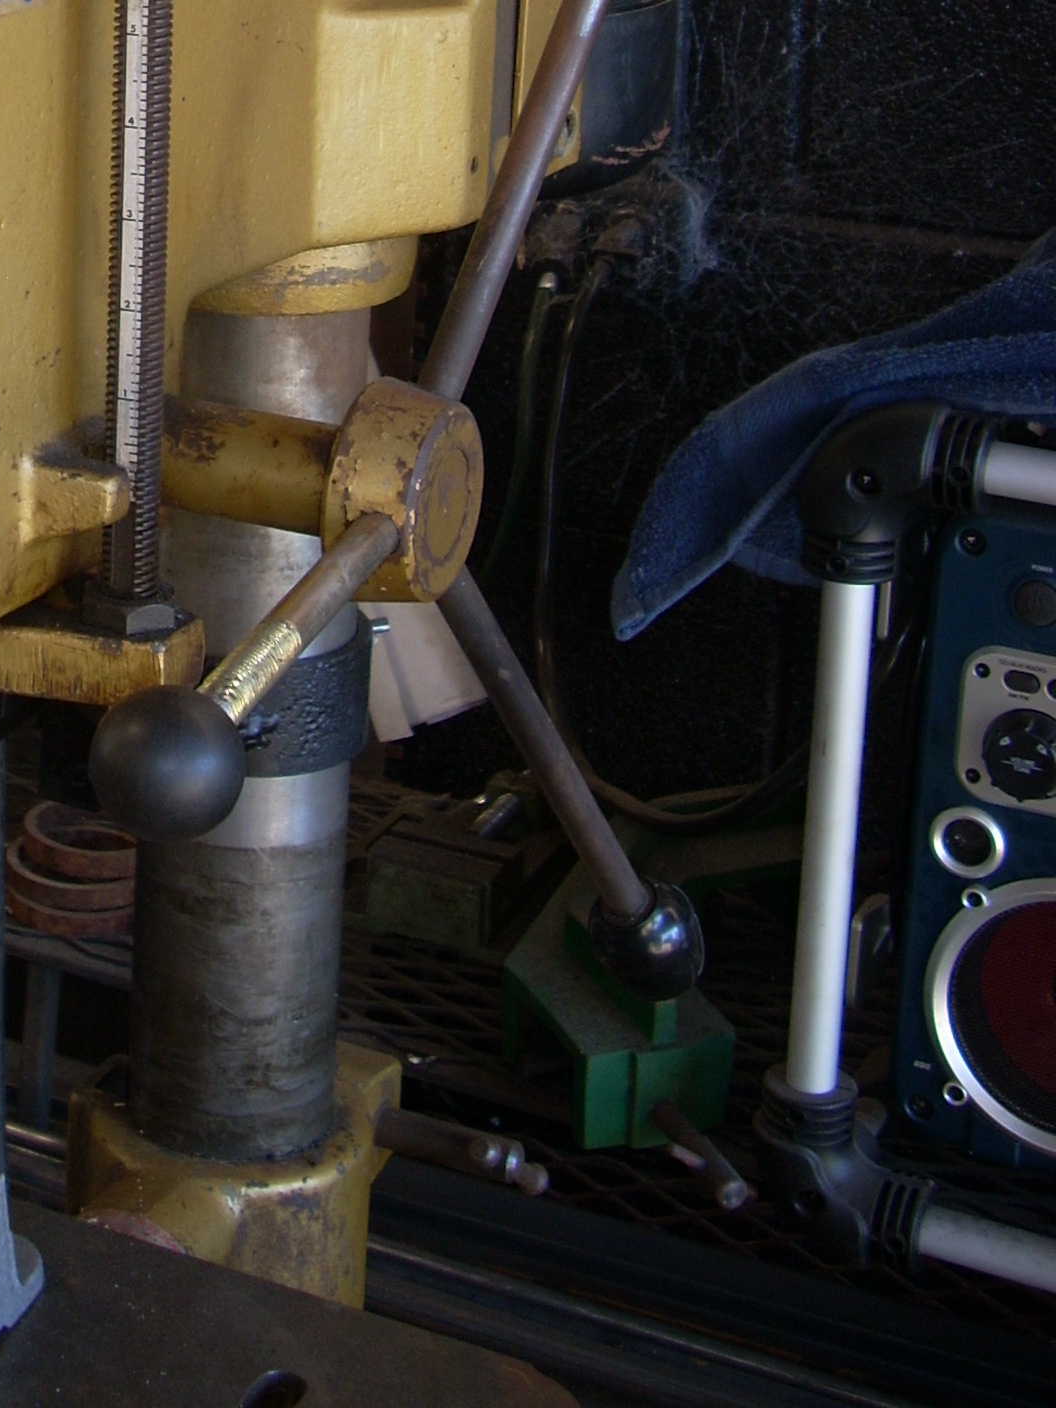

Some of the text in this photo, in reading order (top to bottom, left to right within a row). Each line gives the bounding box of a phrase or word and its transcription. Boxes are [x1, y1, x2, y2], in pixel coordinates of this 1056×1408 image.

[130, 24, 137, 33] 5
[128, 117, 135, 125] 4
[126, 209, 132, 218] 3
[124, 300, 131, 309] 2
[122, 389, 127, 397] 1
